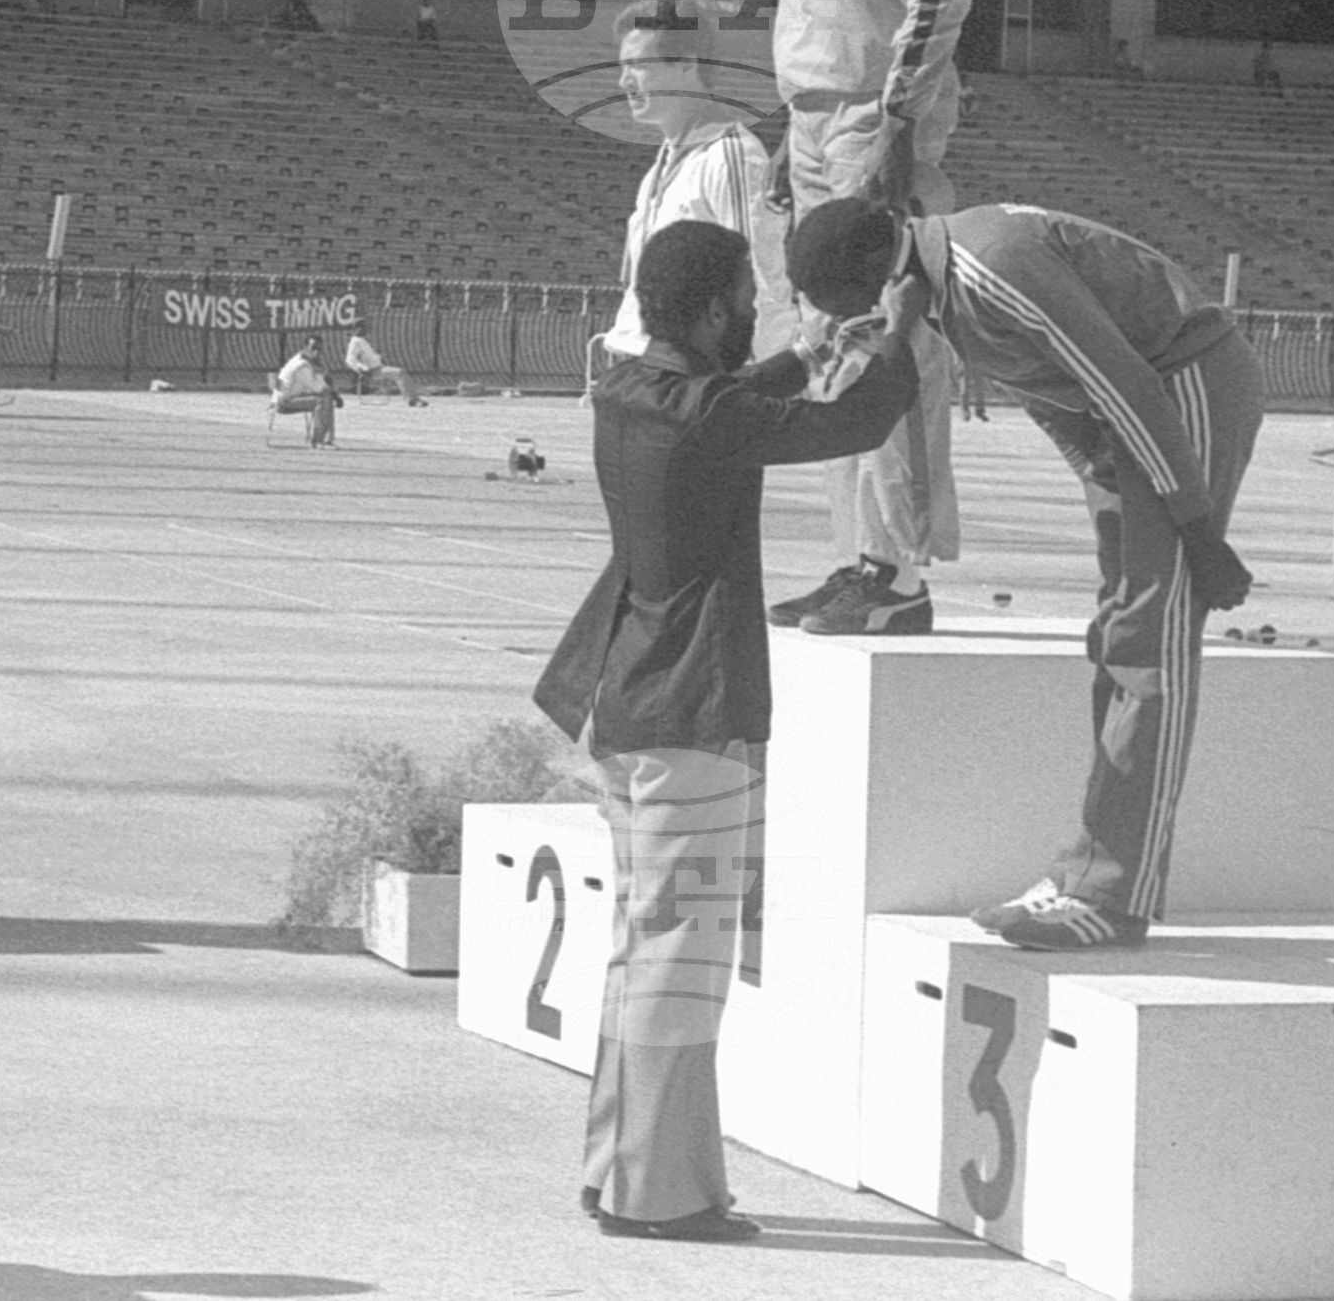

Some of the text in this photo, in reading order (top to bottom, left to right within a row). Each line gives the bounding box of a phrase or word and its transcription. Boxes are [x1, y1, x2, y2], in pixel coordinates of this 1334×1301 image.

[164, 289, 360, 330] SWISS TIMING
[526, 844, 565, 1040] 2
[961, 982, 1016, 1221] 3
